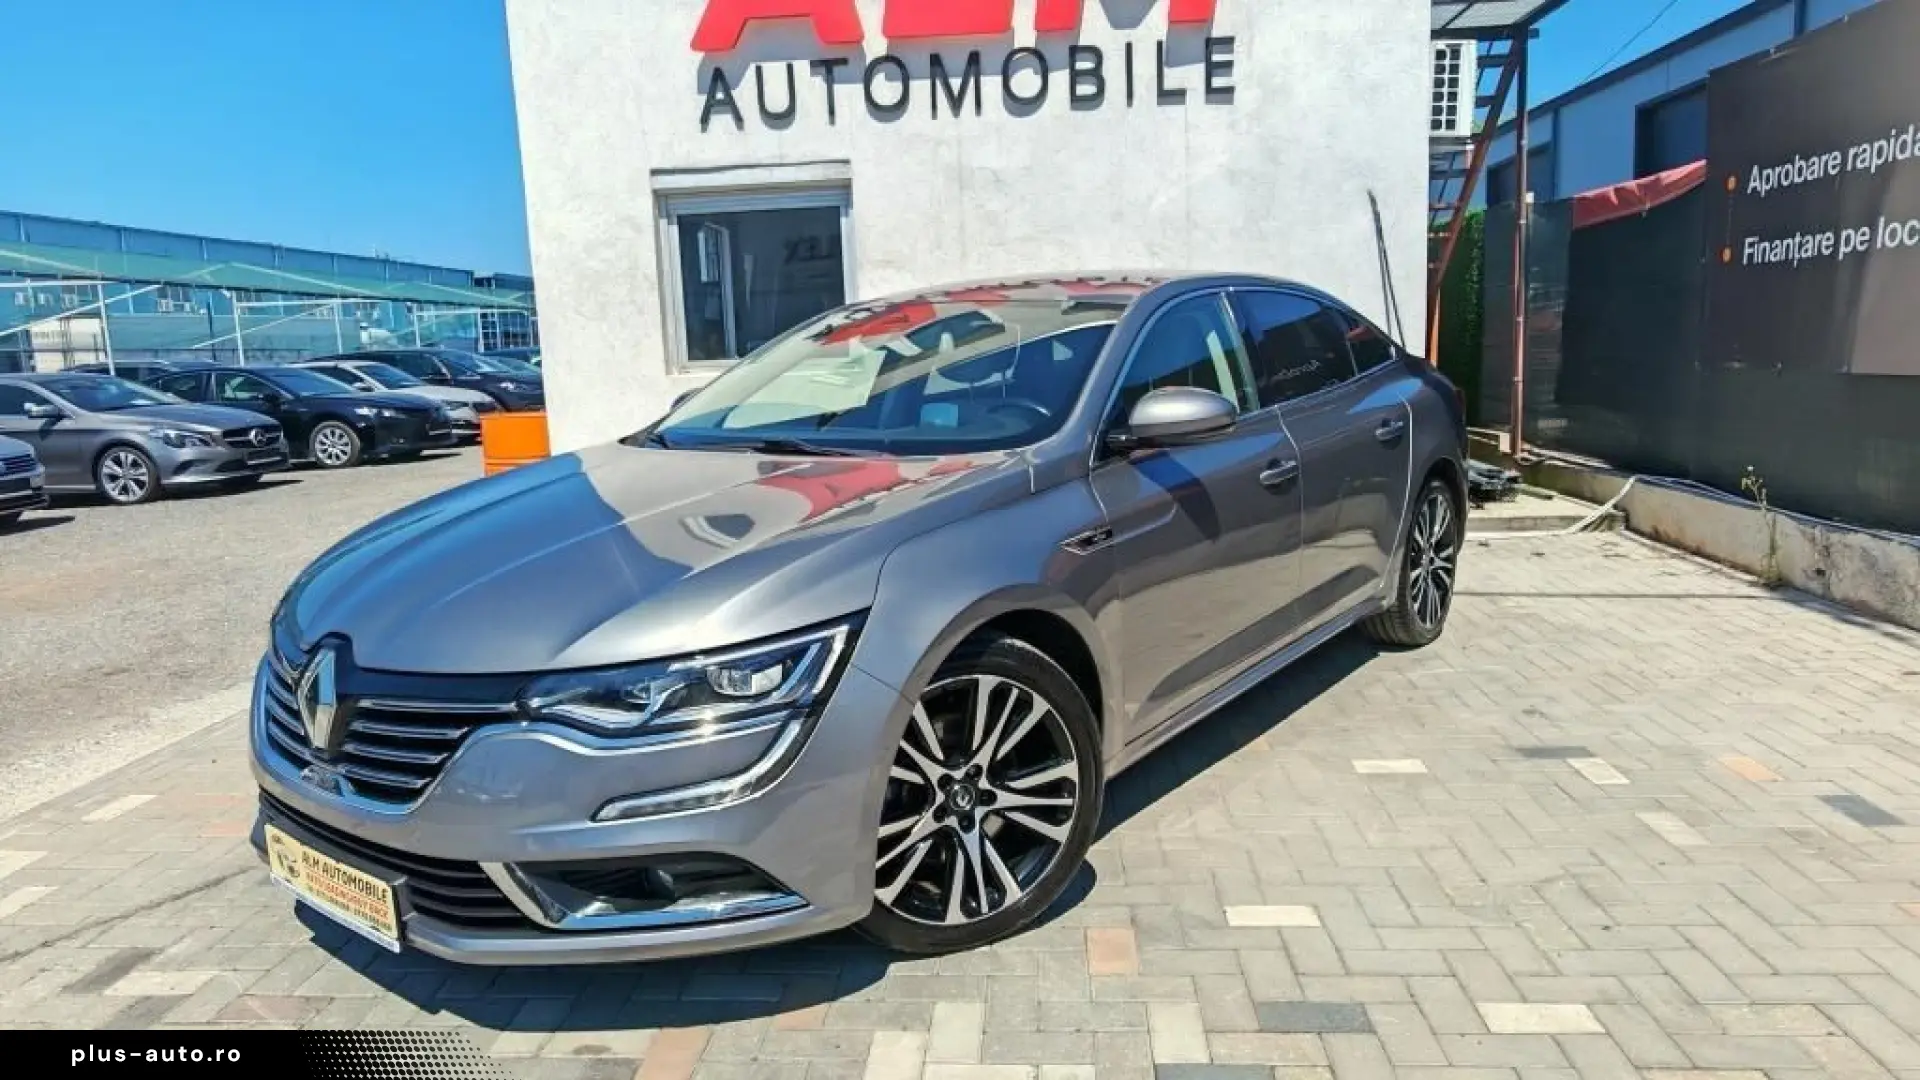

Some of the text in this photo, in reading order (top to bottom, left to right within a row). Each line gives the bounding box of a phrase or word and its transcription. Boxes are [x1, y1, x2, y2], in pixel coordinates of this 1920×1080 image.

[700, 36, 1236, 130] AUTOMOBILE
[1747, 151, 1842, 198] Aprobare
[1742, 216, 1920, 268] Finanțare pe loc
[322, 860, 389, 904] AUTOMOBILE
